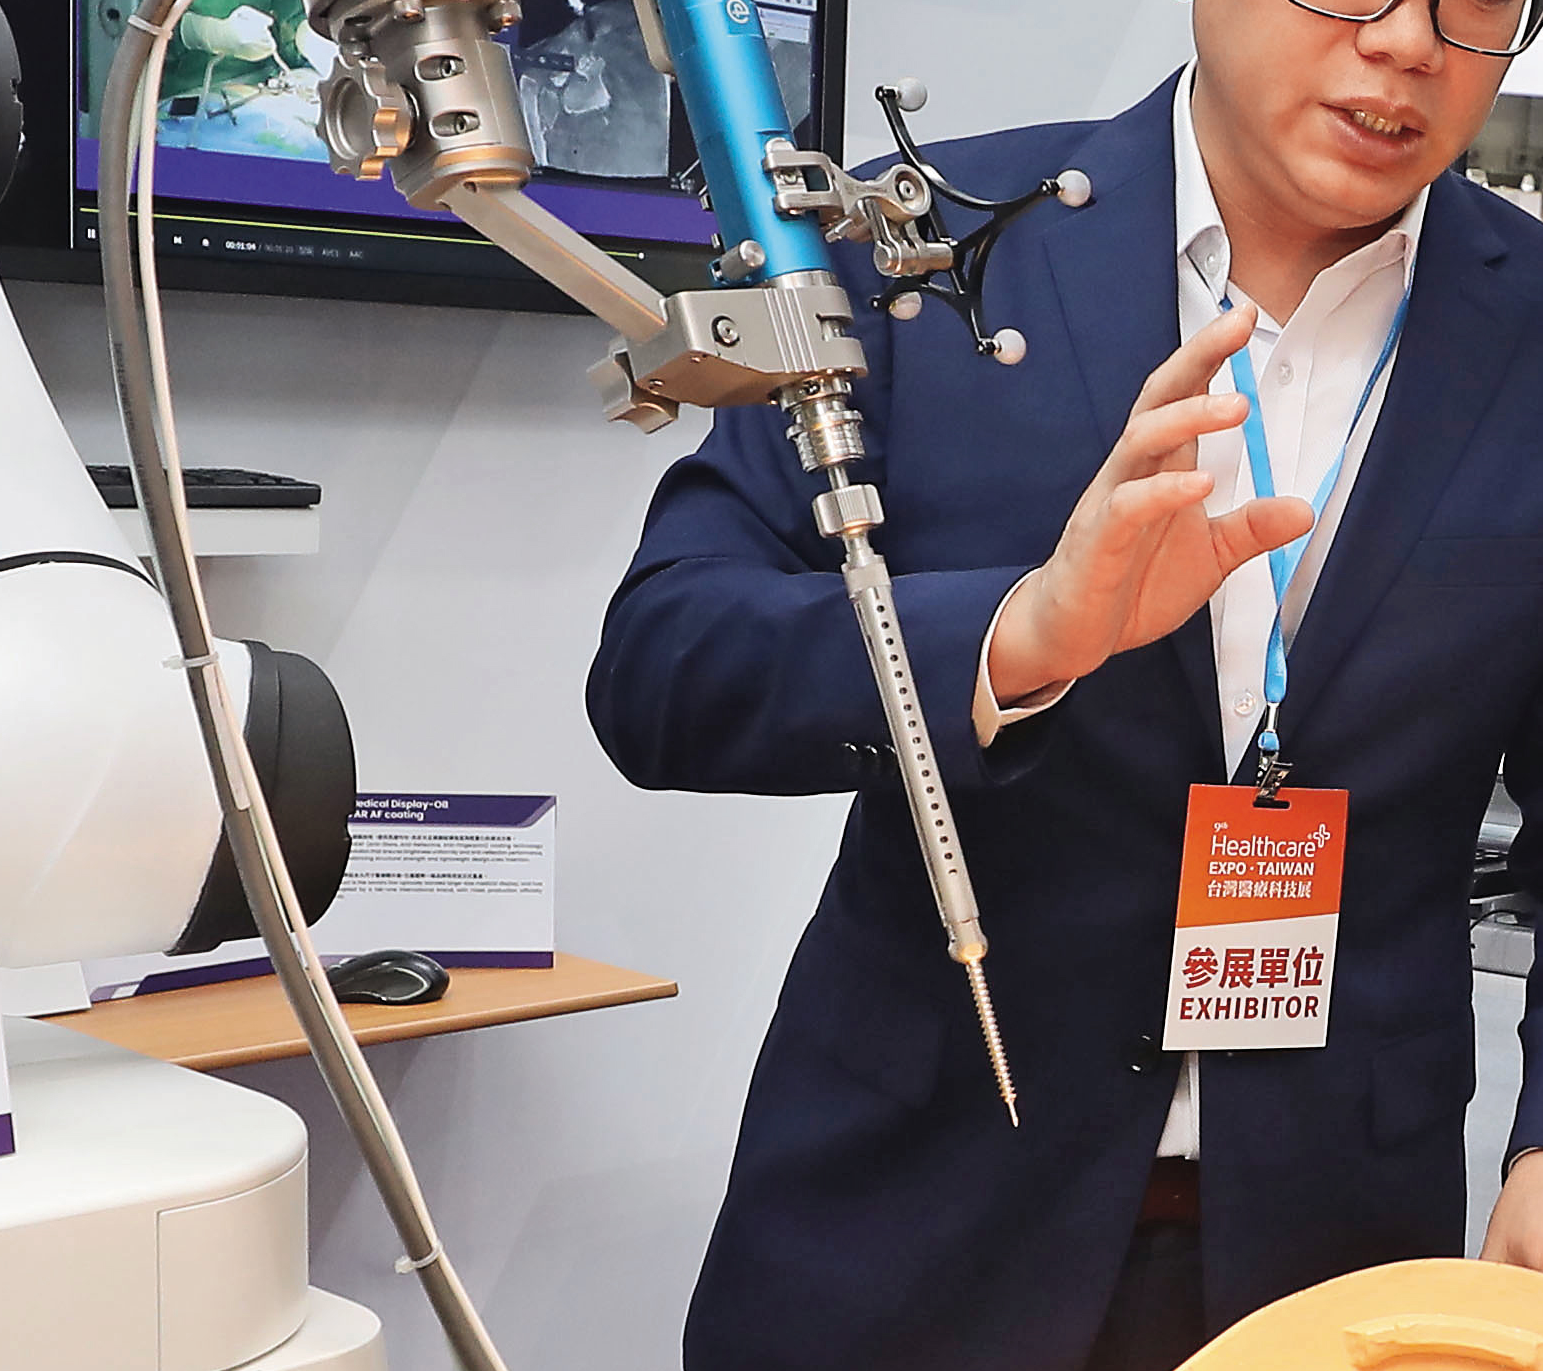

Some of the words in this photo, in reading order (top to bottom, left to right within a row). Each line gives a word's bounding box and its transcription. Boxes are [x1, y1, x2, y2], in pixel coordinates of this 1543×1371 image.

[355, 799, 389, 809] edical
[385, 810, 425, 821] coating
[1210, 834, 1315, 858] Healthcare
[1208, 862, 1246, 876] EXPO
[1257, 862, 1314, 876] TAIWAN
[1207, 880, 1312, 899] 台灣醫療科技展
[1182, 946, 1324, 989] 參展單位
[1179, 996, 1318, 1020] EXHIBITOR
